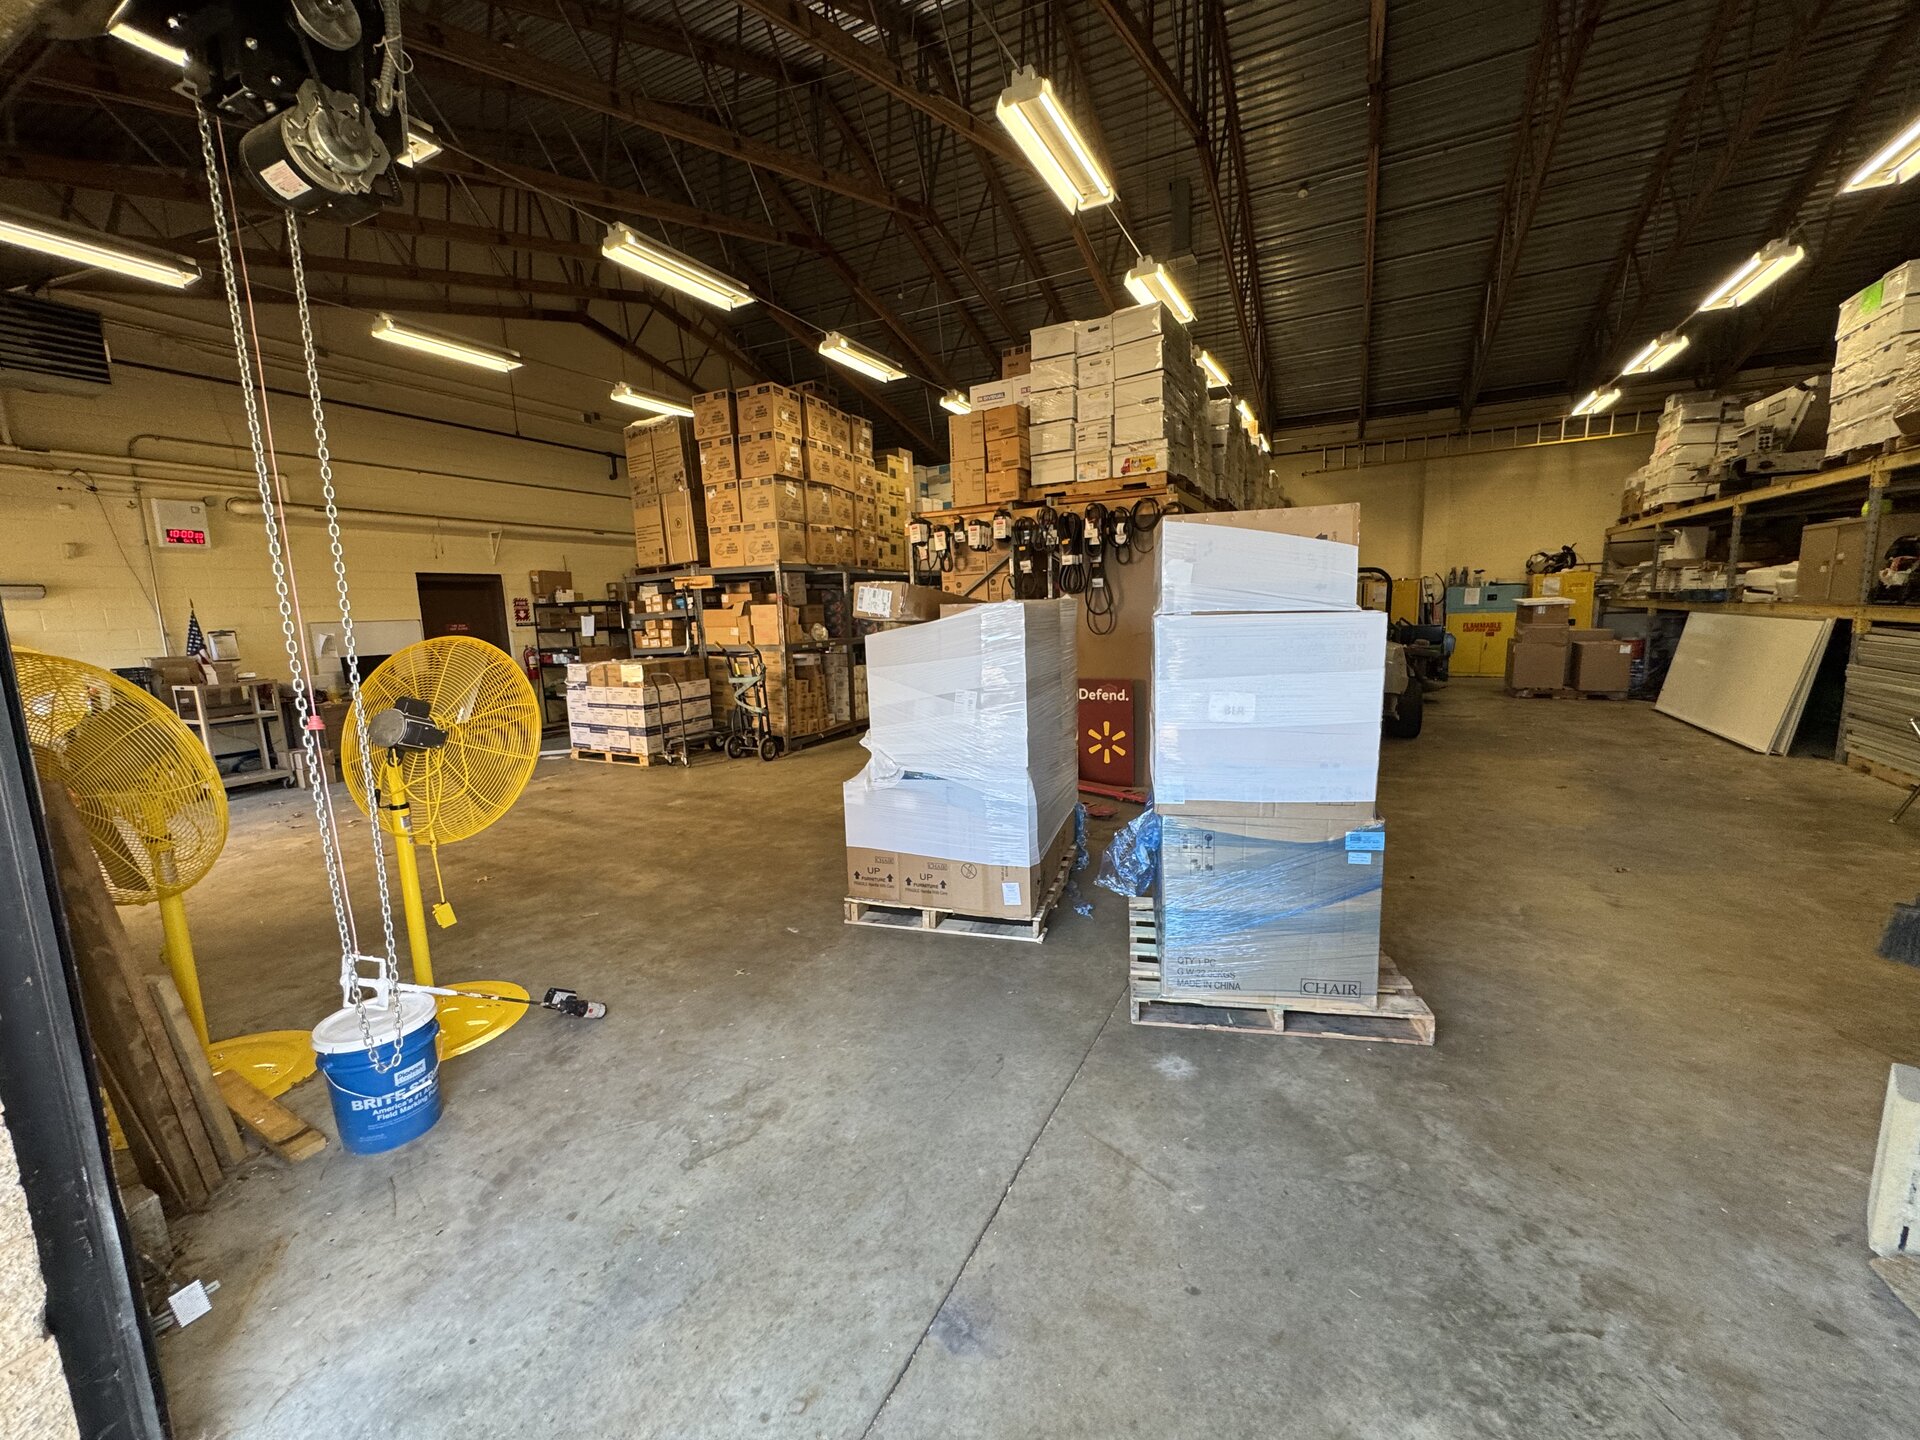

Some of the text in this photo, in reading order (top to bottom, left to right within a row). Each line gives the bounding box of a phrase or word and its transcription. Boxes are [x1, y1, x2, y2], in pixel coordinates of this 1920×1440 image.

[1078, 688, 1129, 701] Defend.
[919, 873, 933, 881] UP
[1177, 979, 1241, 991] MADE IN CHINA
[1303, 981, 1358, 996] CHAIR
[351, 1088, 407, 1111] BRITE
[372, 1098, 414, 1116] America's
[376, 1109, 398, 1122] Field
[400, 1096, 428, 1114] Marking
